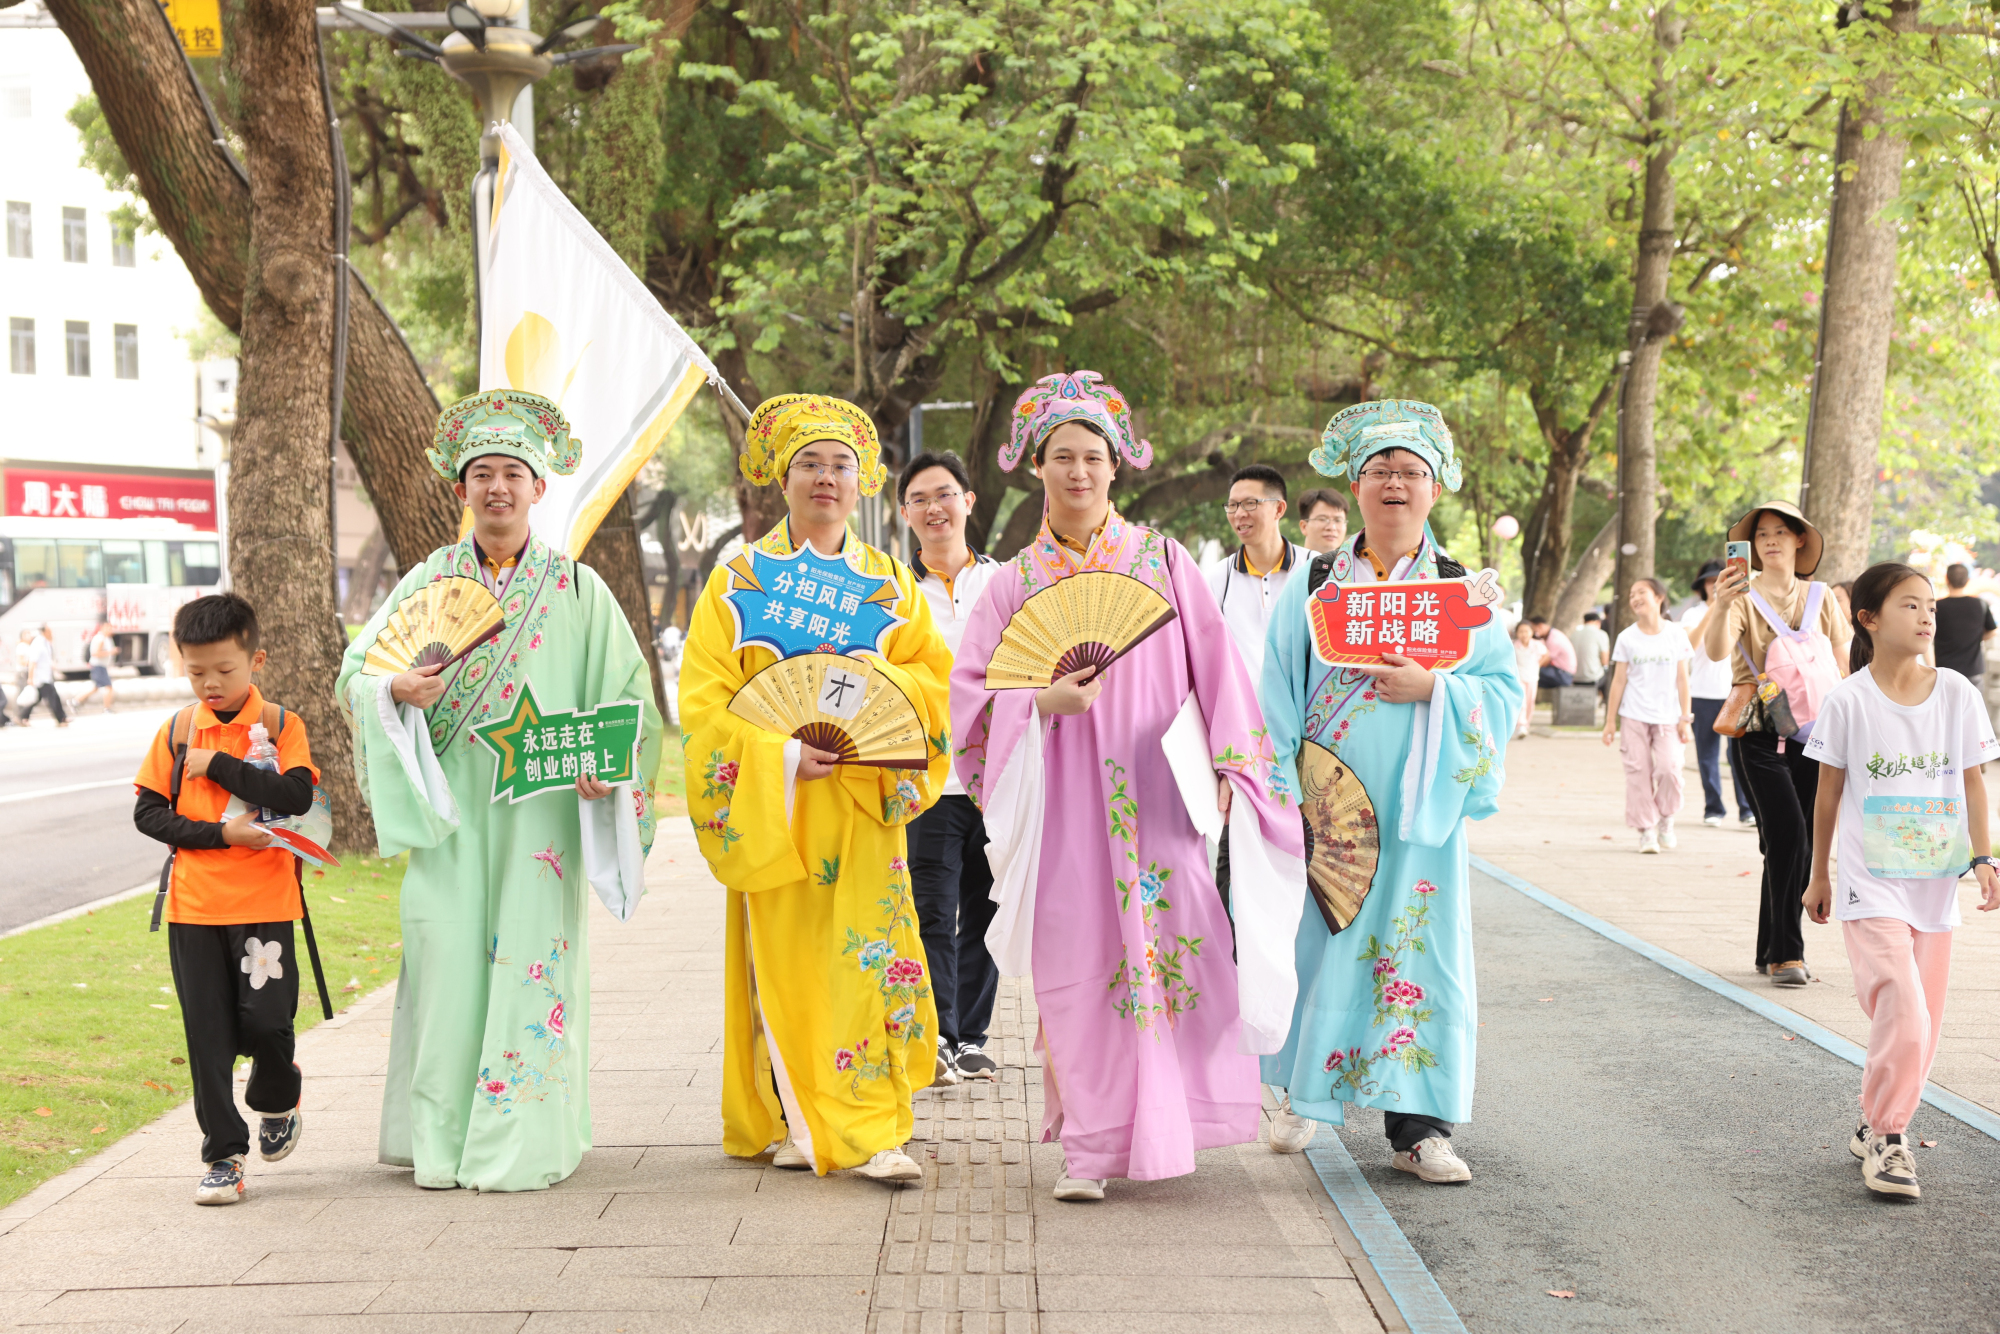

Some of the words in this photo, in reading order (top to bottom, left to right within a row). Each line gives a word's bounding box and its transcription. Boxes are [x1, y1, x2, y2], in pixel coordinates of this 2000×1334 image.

[21, 481, 109, 518] 周大福
[119, 496, 155, 511] CHOW
[772, 570, 863, 617] 分担风雨
[1346, 591, 1440, 617] 新阳光
[762, 599, 852, 645] 共享阳光
[1345, 619, 1440, 645] 新战略
[825, 674, 855, 708] 才
[522, 721, 595, 754] 永远走在
[524, 748, 617, 782] 创业的路上
